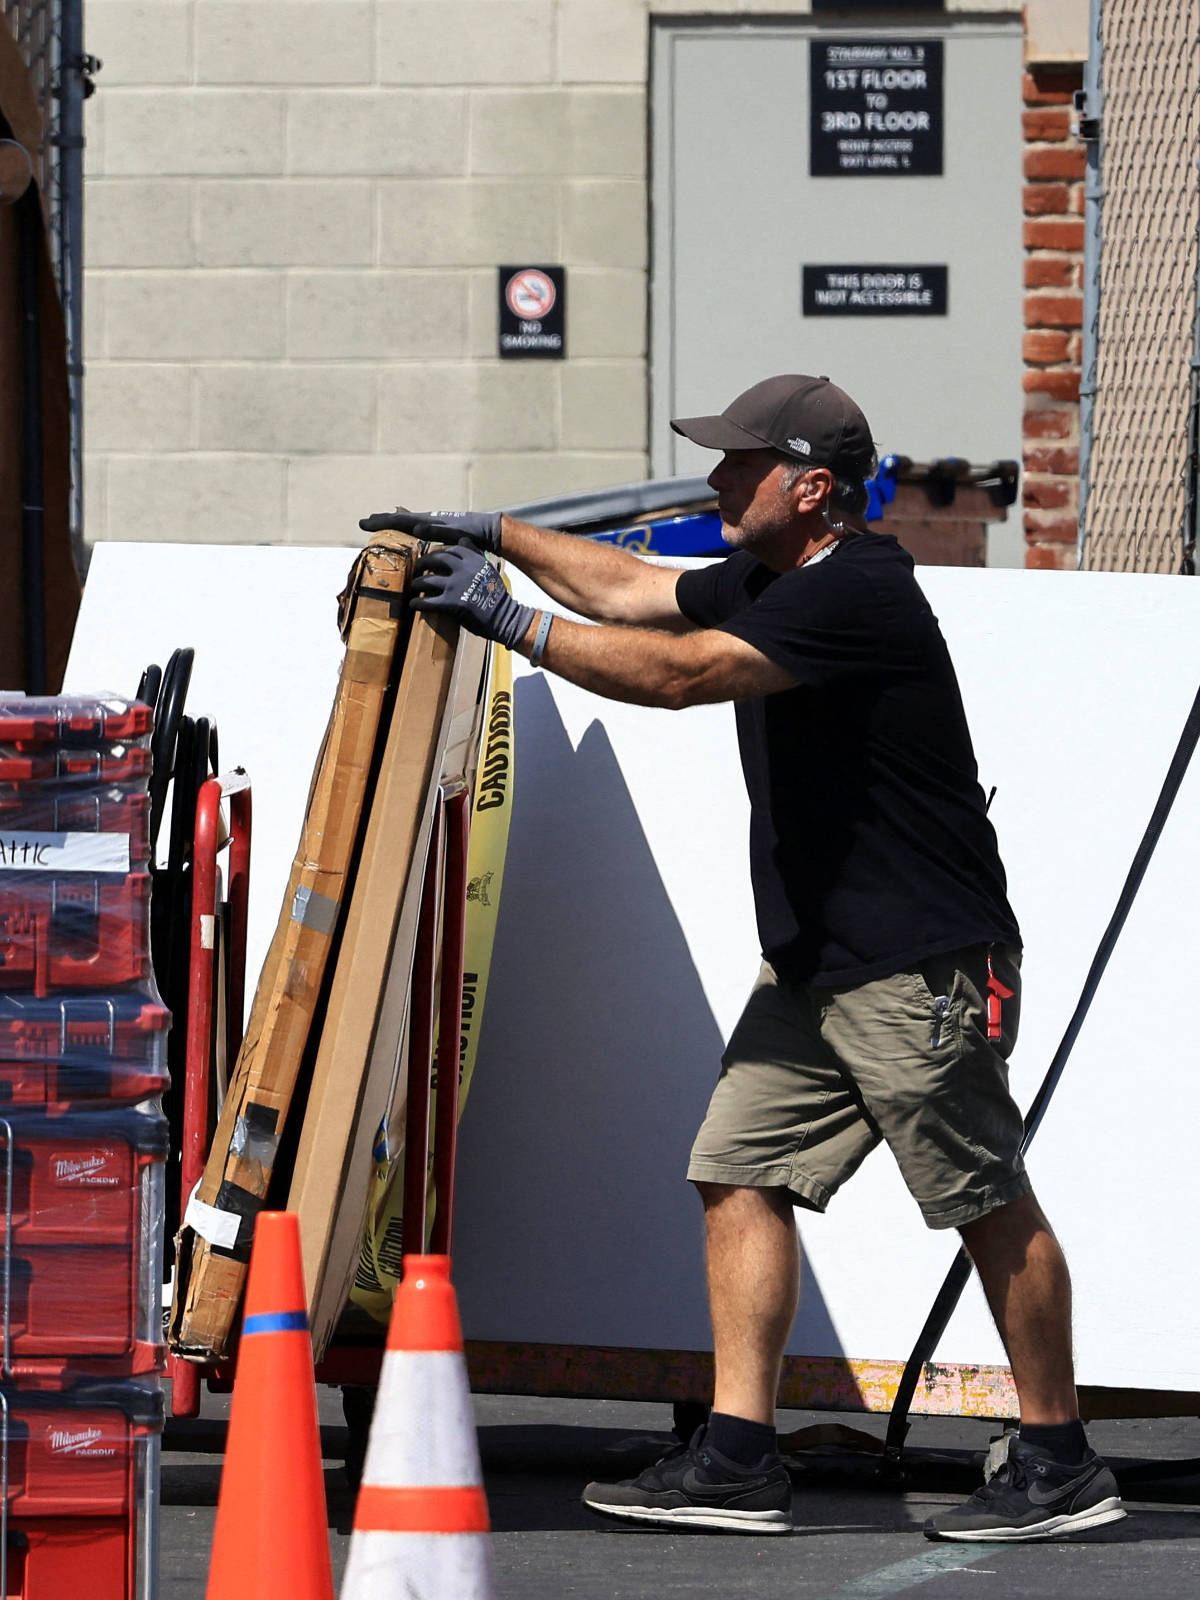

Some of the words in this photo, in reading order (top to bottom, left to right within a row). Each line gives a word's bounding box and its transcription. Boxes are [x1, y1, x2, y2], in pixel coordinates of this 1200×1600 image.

[825, 69, 858, 89] 1ST
[861, 69, 928, 89] FLOOR
[865, 92, 888, 110] TO
[821, 111, 861, 131] 3RD
[864, 111, 930, 131] FLOOR
[825, 273, 860, 289] THIS
[862, 273, 905, 289] DOOR
[908, 273, 923, 289] IS
[815, 289, 848, 306] NOT
[849, 289, 934, 306] ACCESSIBLE
[520, 320, 542, 334] NO
[501, 334, 562, 350] SMOKING
[476, 690, 511, 813] CAUTION
[80, 1176, 120, 1184] PACKOUT
[49, 1426, 103, 1449] Milwaukee
[76, 1448, 117, 1456] PACKOUT
